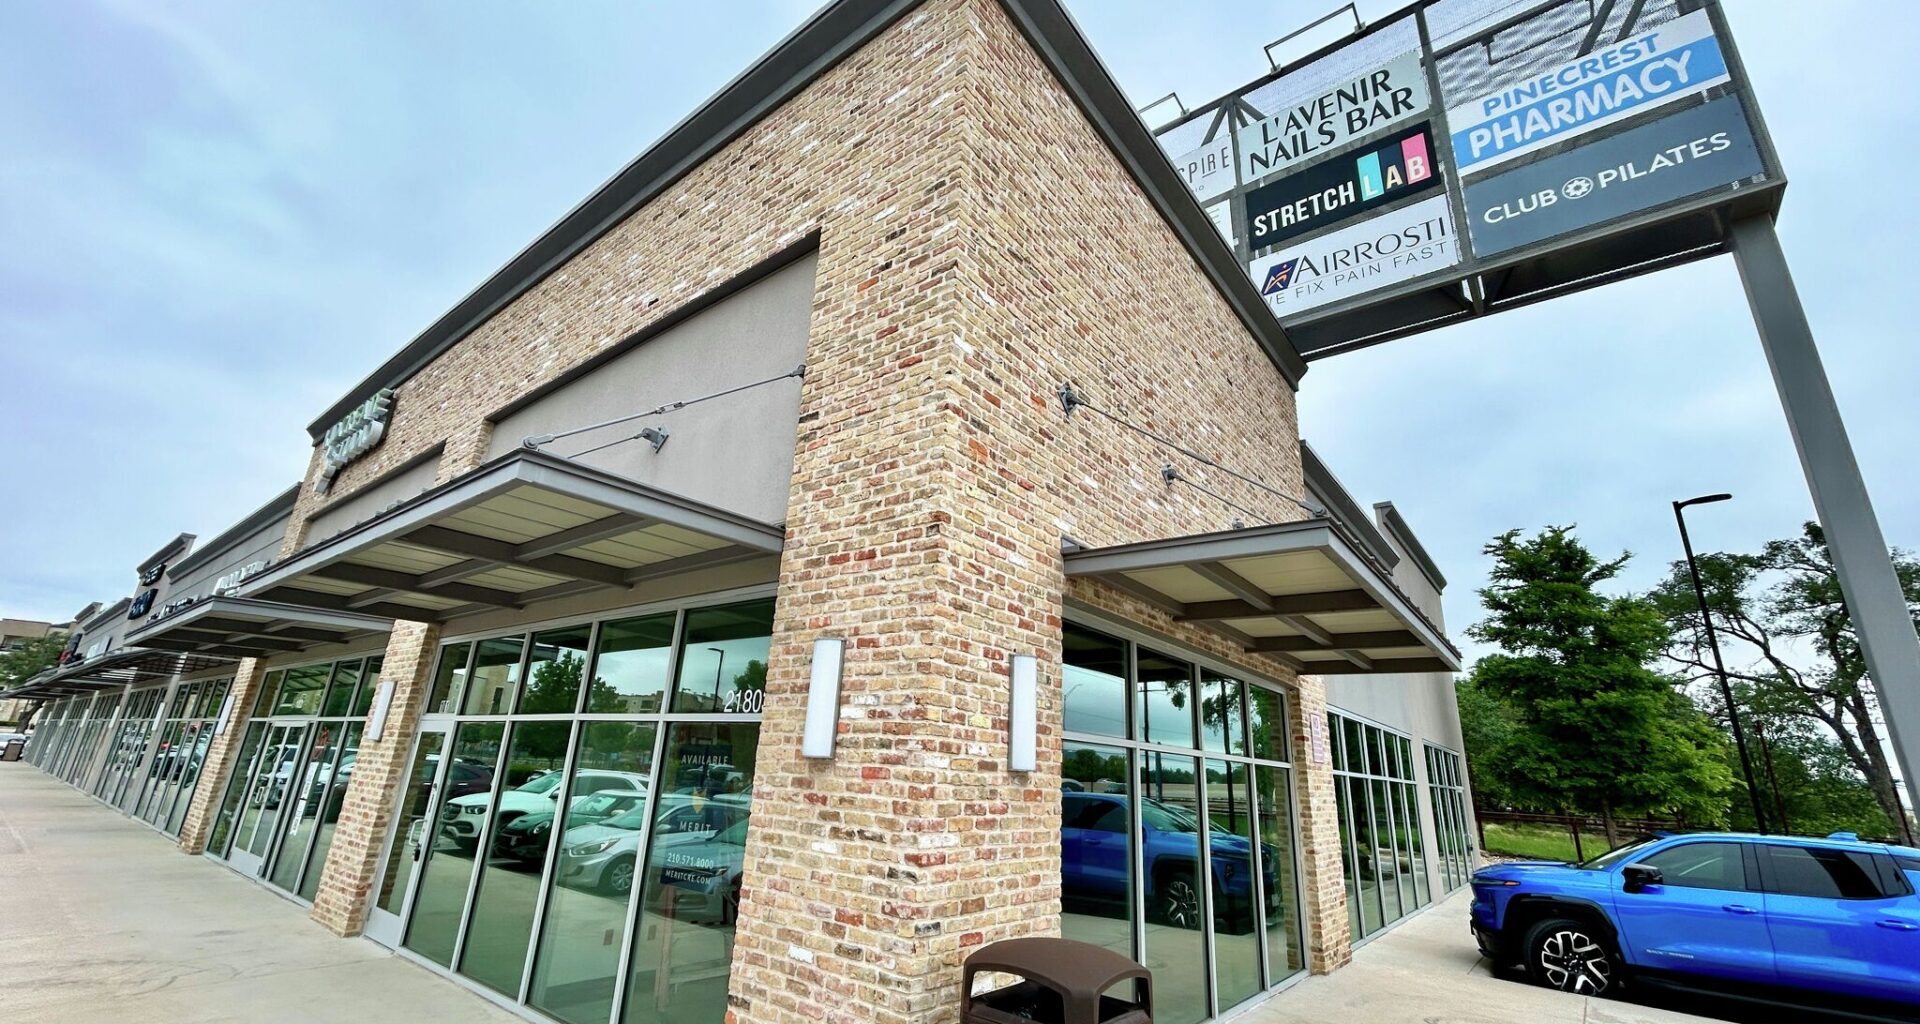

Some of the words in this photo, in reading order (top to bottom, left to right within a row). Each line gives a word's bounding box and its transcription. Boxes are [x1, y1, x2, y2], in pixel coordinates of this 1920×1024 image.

[1261, 69, 1393, 145] L'AVENIR
[1469, 49, 1692, 158] PHARMACY
[1484, 32, 1660, 117] PINECREST
[1250, 120, 1336, 175] NAILS
[1346, 87, 1415, 135] BAR
[1254, 181, 1356, 237] STRETCH
[1484, 187, 1558, 224] CLUB
[1599, 132, 1732, 190] PILATES
[1294, 217, 1446, 284] AIRROSTI
[1295, 280, 1324, 298] FIX
[1334, 263, 1381, 286] PAIN
[1393, 241, 1447, 269] FAST
[723, 689, 766, 713] 2180
[681, 754, 729, 765] AVAILABLE
[679, 821, 711, 833] MERIT
